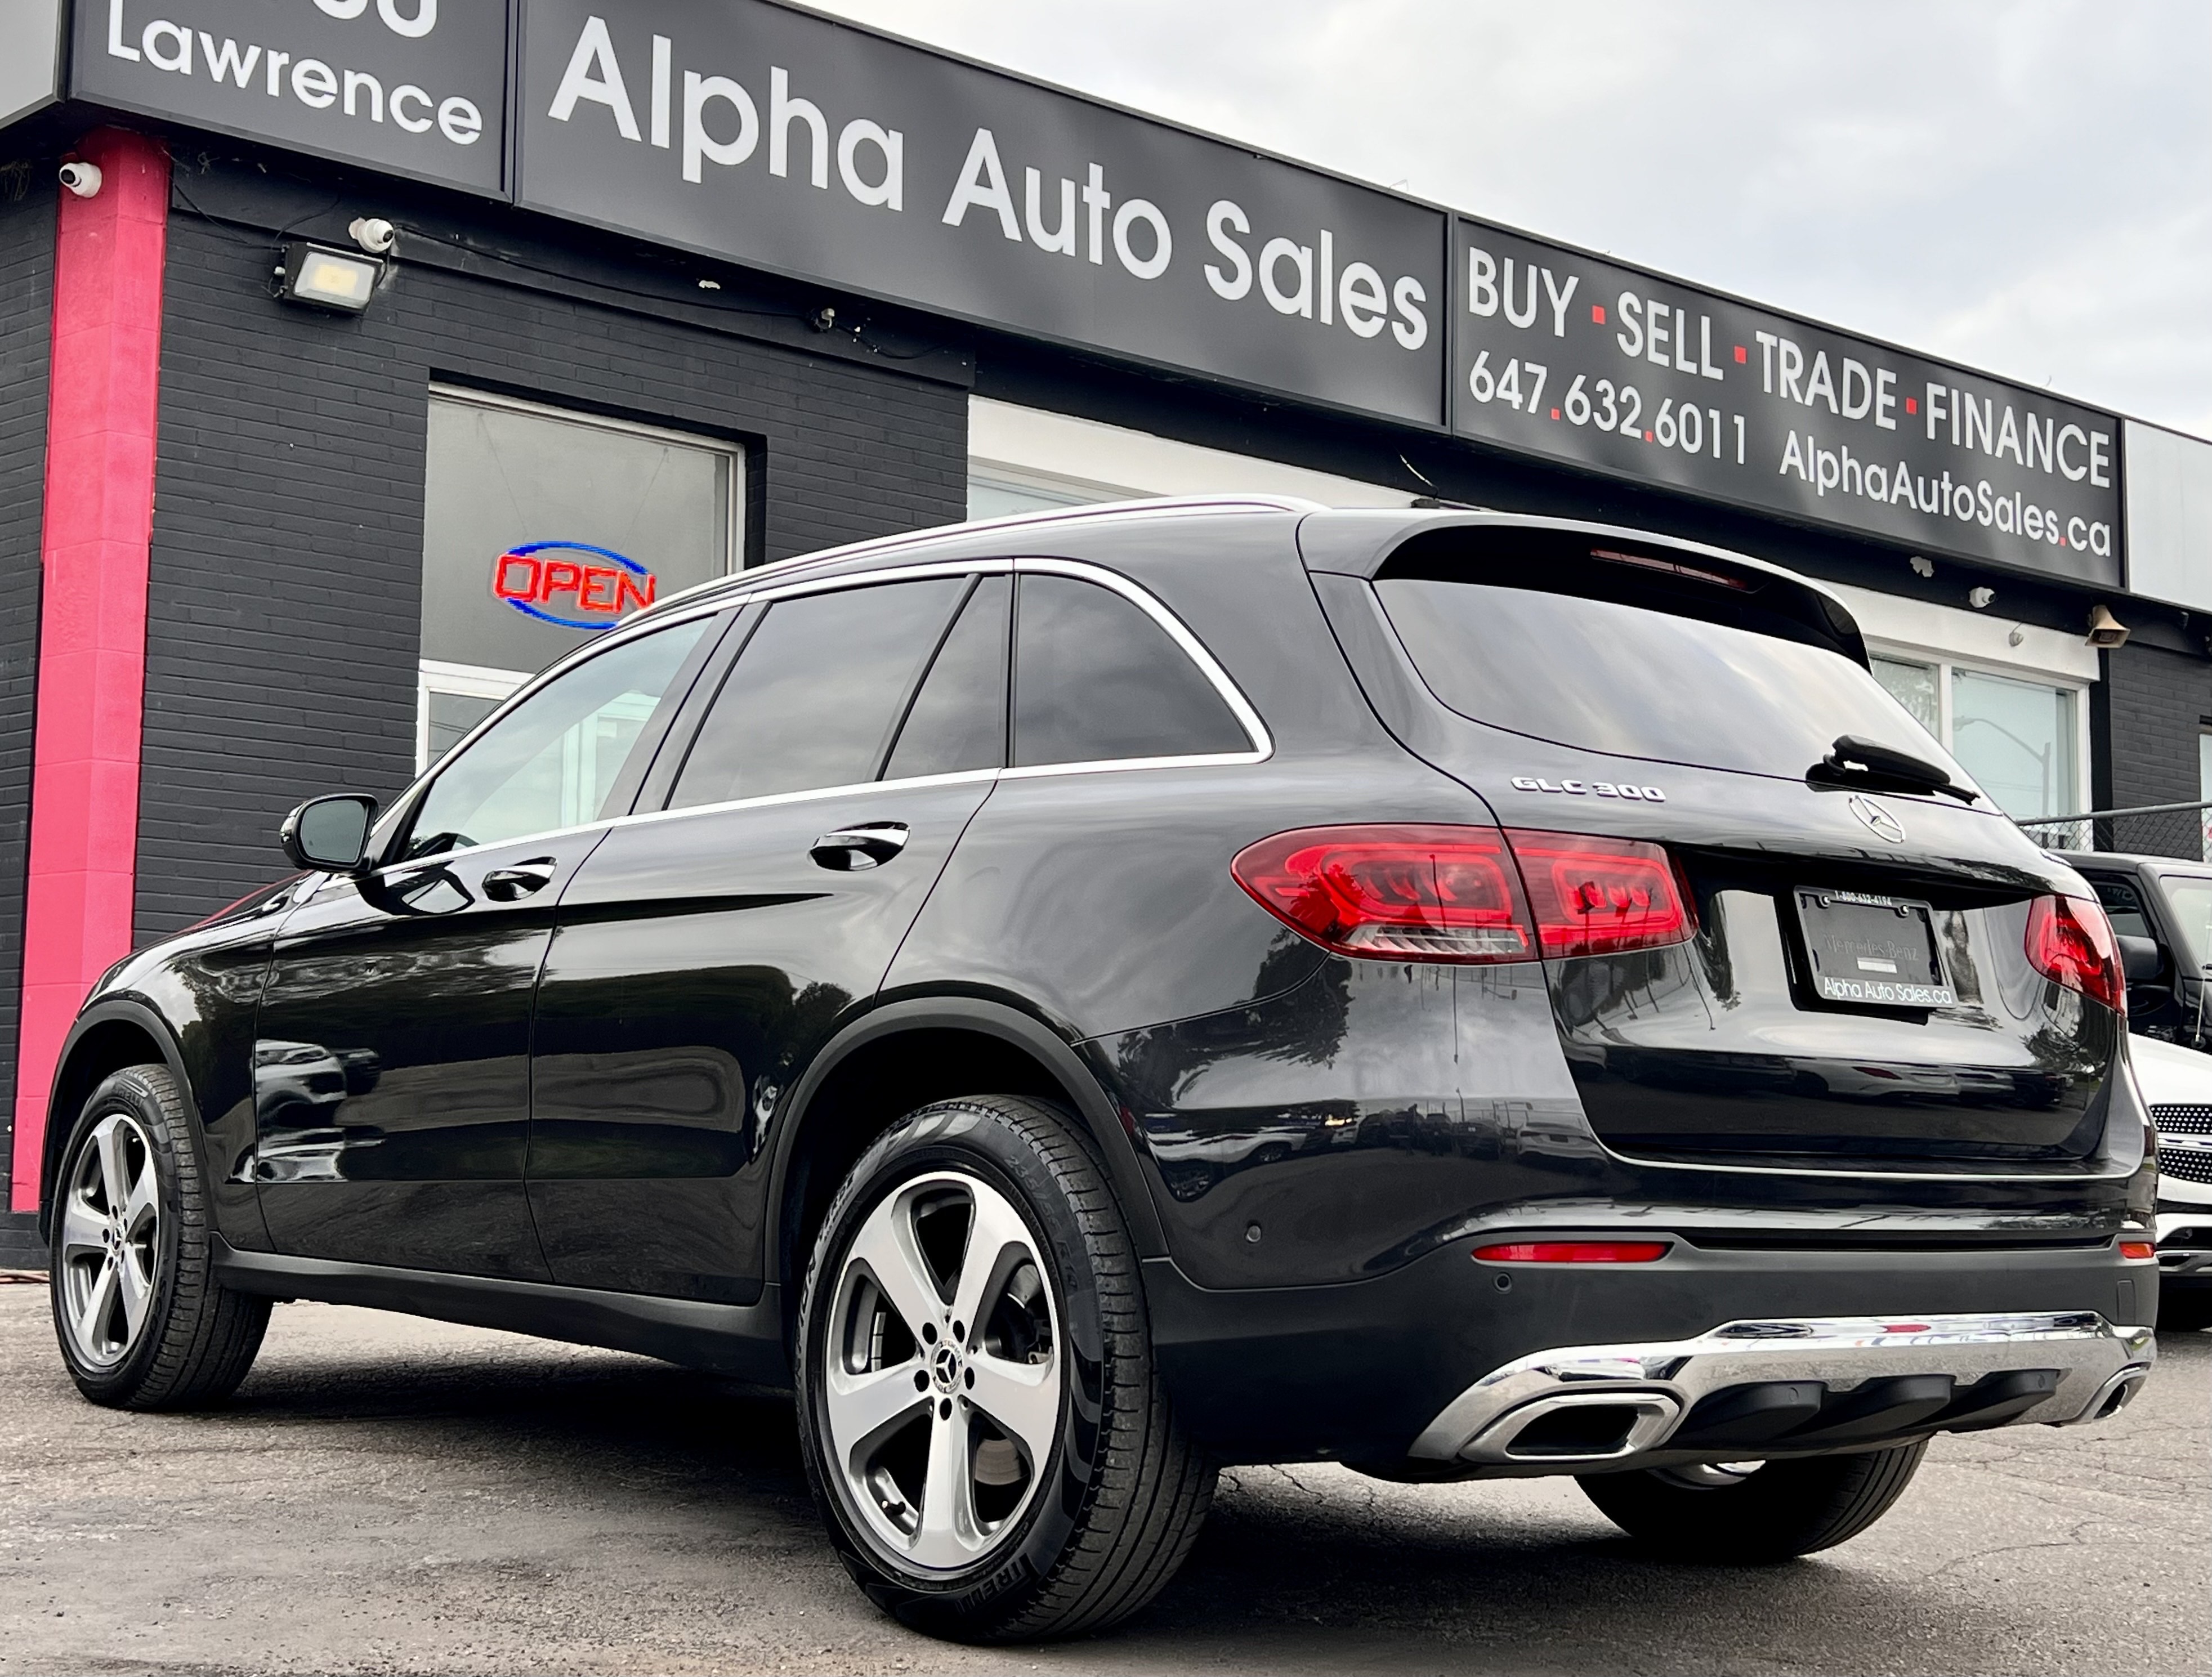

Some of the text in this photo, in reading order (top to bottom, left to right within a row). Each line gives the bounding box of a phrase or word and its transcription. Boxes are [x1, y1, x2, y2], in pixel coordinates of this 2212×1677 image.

[108, 0, 482, 145] Lawrence
[548, 15, 1428, 351] Alpha Auto Sales
[1468, 246, 2111, 489] BUY SELL TRADE FINANCE
[1468, 350, 1745, 465] 647.632.6011
[1779, 430, 2111, 557] AlphaAutoSales.ca
[493, 553, 657, 614] OPEN
[1511, 776, 1666, 803] GLC 300
[1824, 977, 1952, 1004] Alpha Auto Sales.ca
